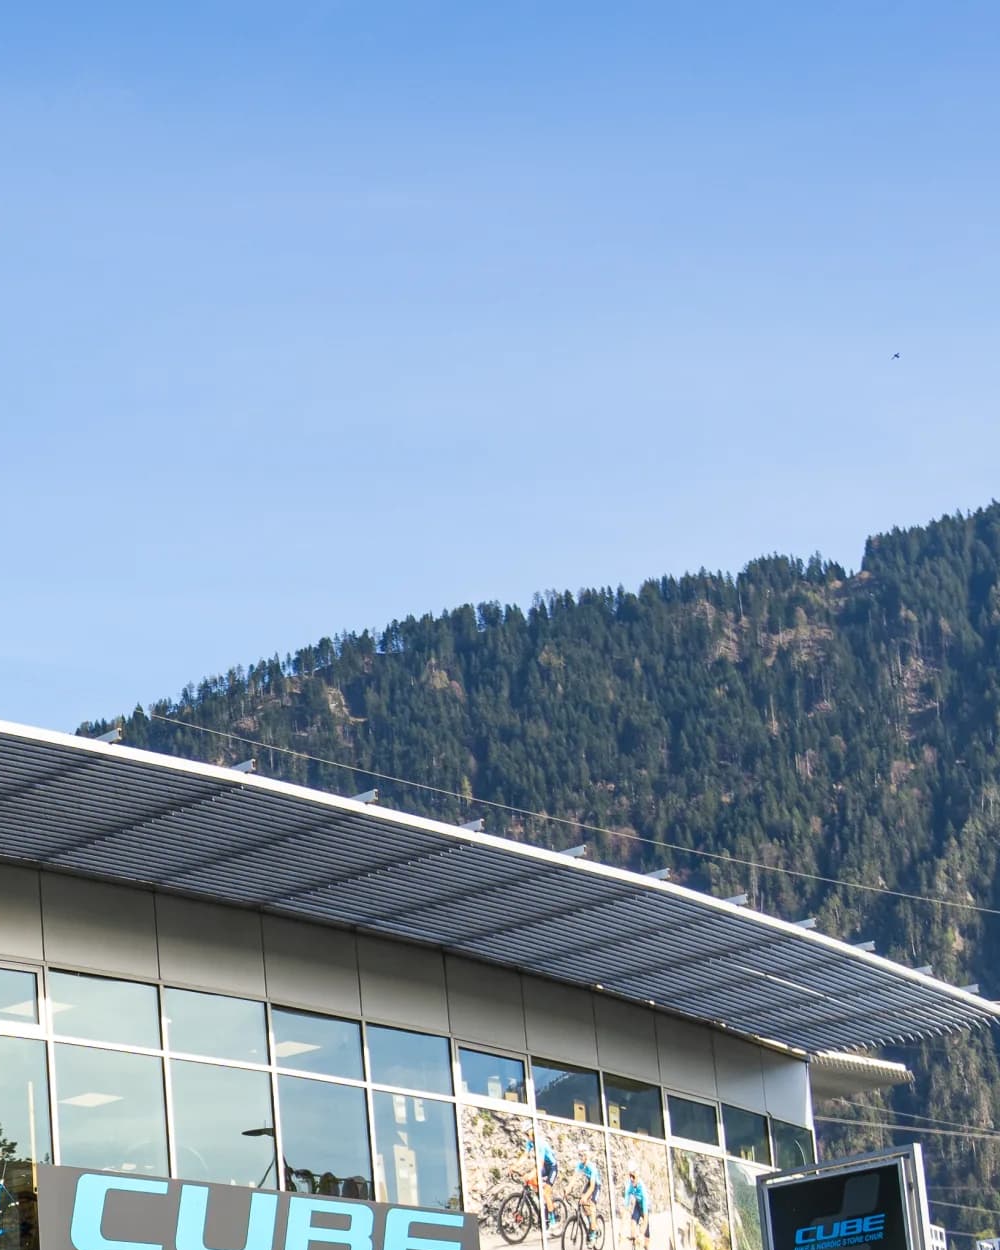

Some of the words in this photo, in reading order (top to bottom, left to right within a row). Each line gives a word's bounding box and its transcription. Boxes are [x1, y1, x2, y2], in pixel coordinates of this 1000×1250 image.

[795, 1213, 886, 1245] CUBE
[817, 1239, 841, 1250] NORDIC
[842, 1235, 864, 1246] STORE
[865, 1232, 884, 1242] CHUR
